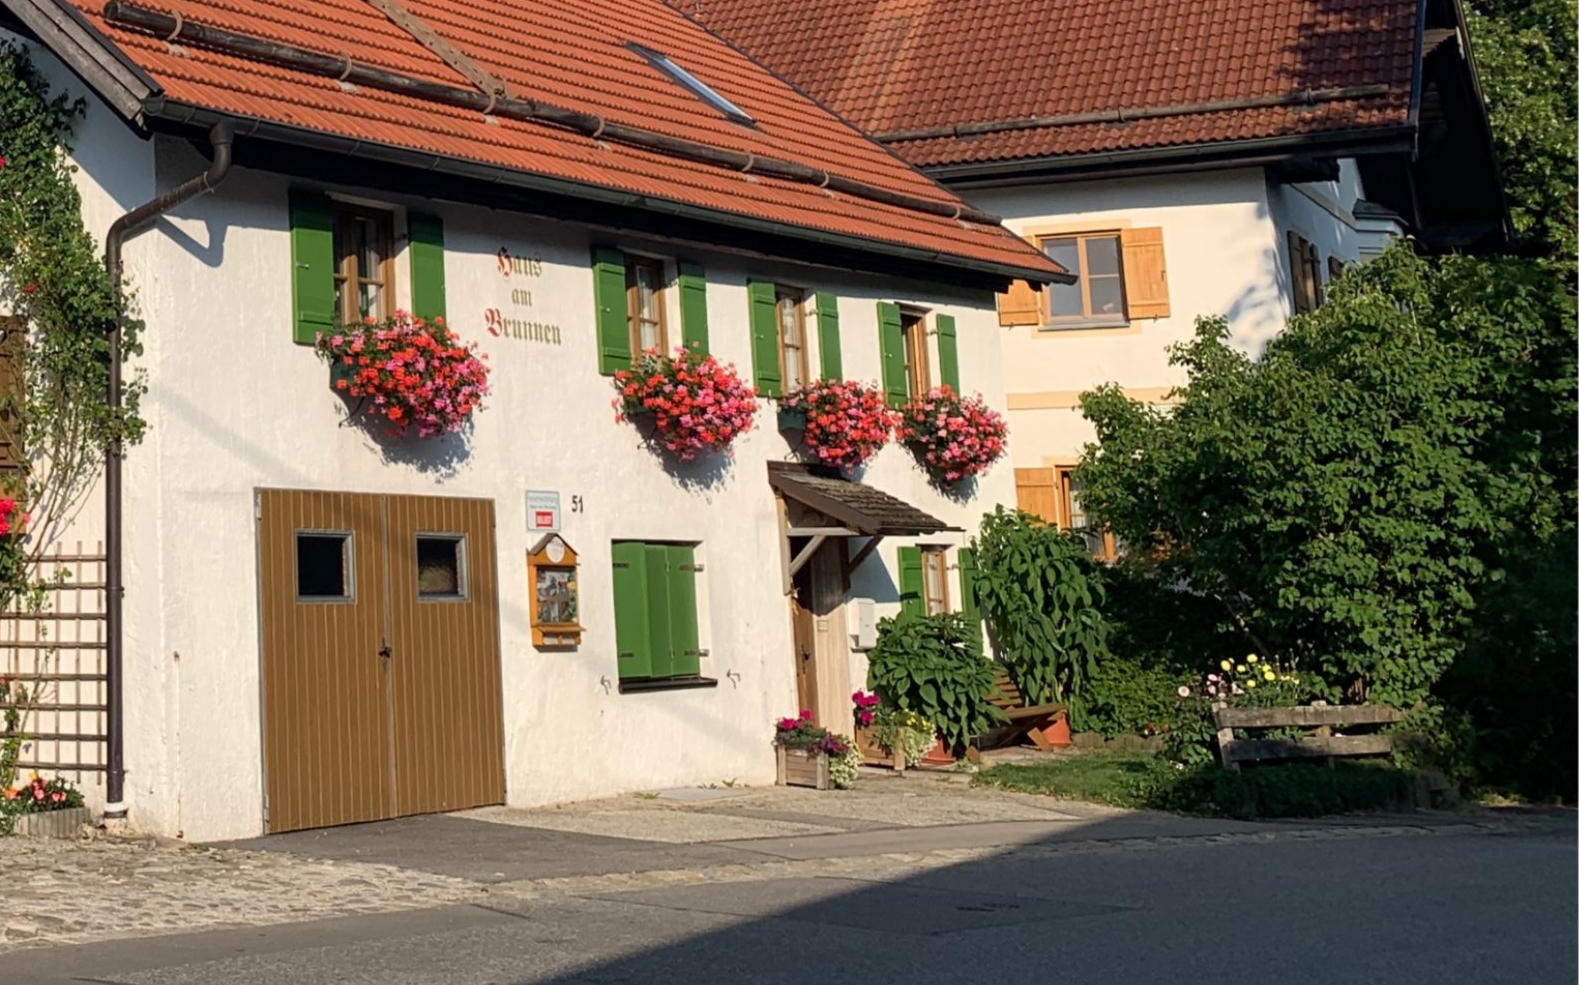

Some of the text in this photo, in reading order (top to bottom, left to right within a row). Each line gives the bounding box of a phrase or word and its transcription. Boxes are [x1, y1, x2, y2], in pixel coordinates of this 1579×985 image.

[497, 246, 543, 281] Haus
[511, 288, 533, 307] am
[484, 308, 562, 346] Brunnen
[572, 495, 584, 513] 51
